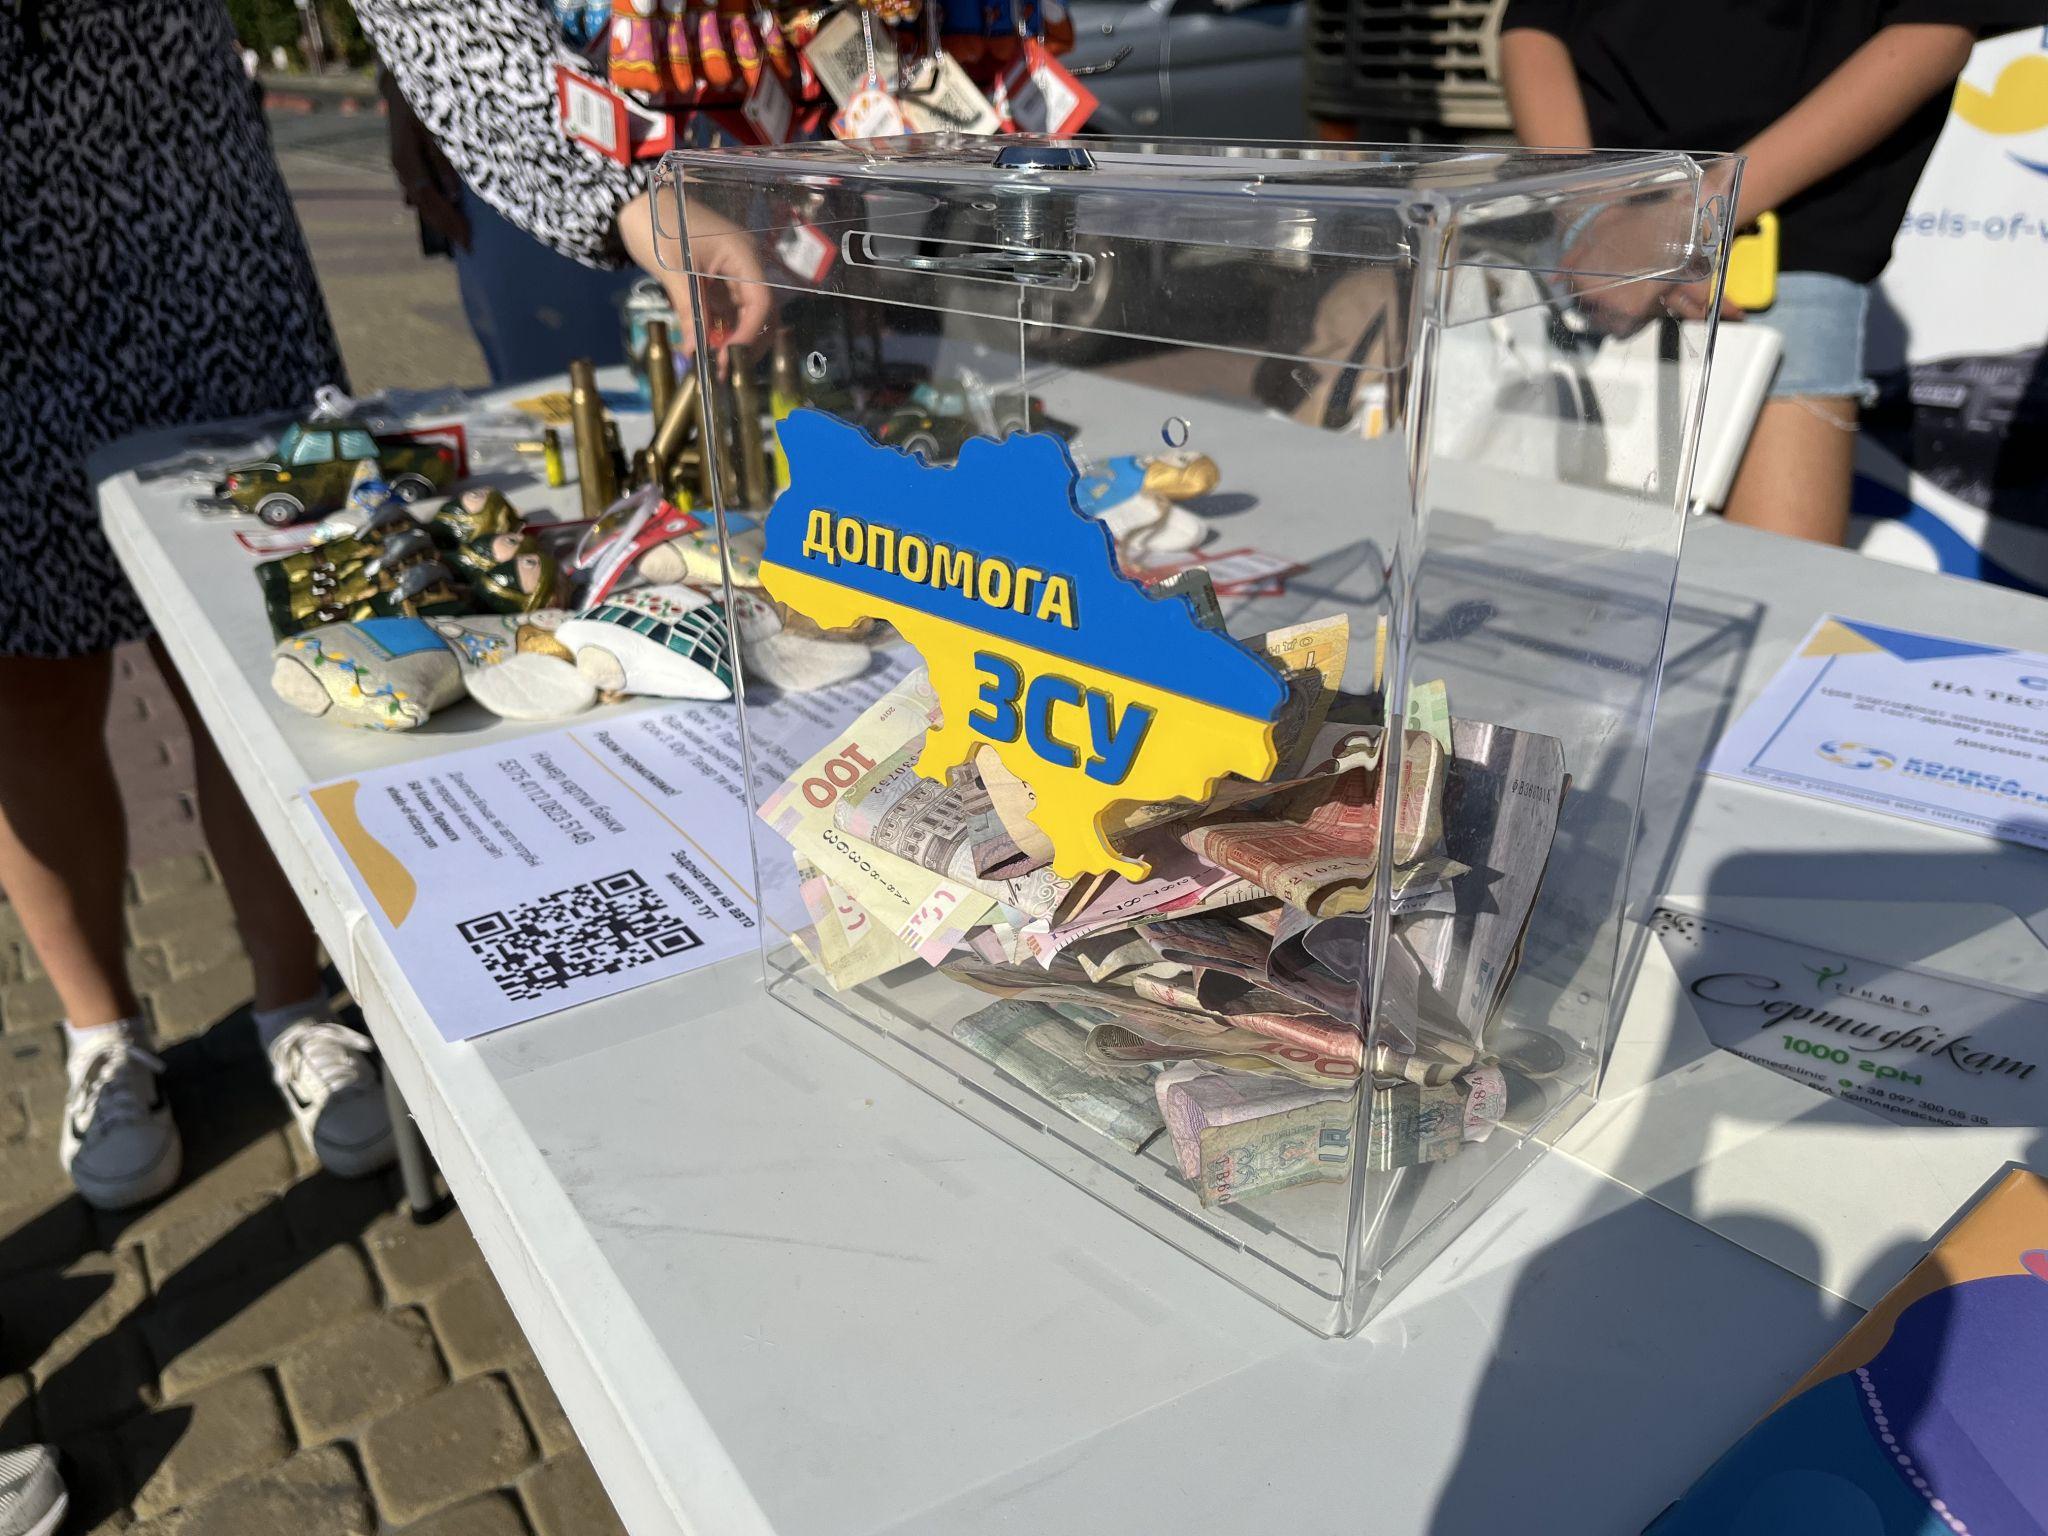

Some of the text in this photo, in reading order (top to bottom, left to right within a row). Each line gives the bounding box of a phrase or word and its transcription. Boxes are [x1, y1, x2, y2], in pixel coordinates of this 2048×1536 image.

[802, 509, 1078, 630] ДОПОМОГА
[968, 649, 1157, 785] ЗСУ
[1984, 689, 2048, 711] ТЕС
[802, 742, 877, 808] 100
[664, 872, 720, 922] можете тут
[667, 849, 757, 928] Задонатити на авто
[1691, 971, 2038, 1081] Сертифікат
[1782, 1034, 1850, 1065] 1000
